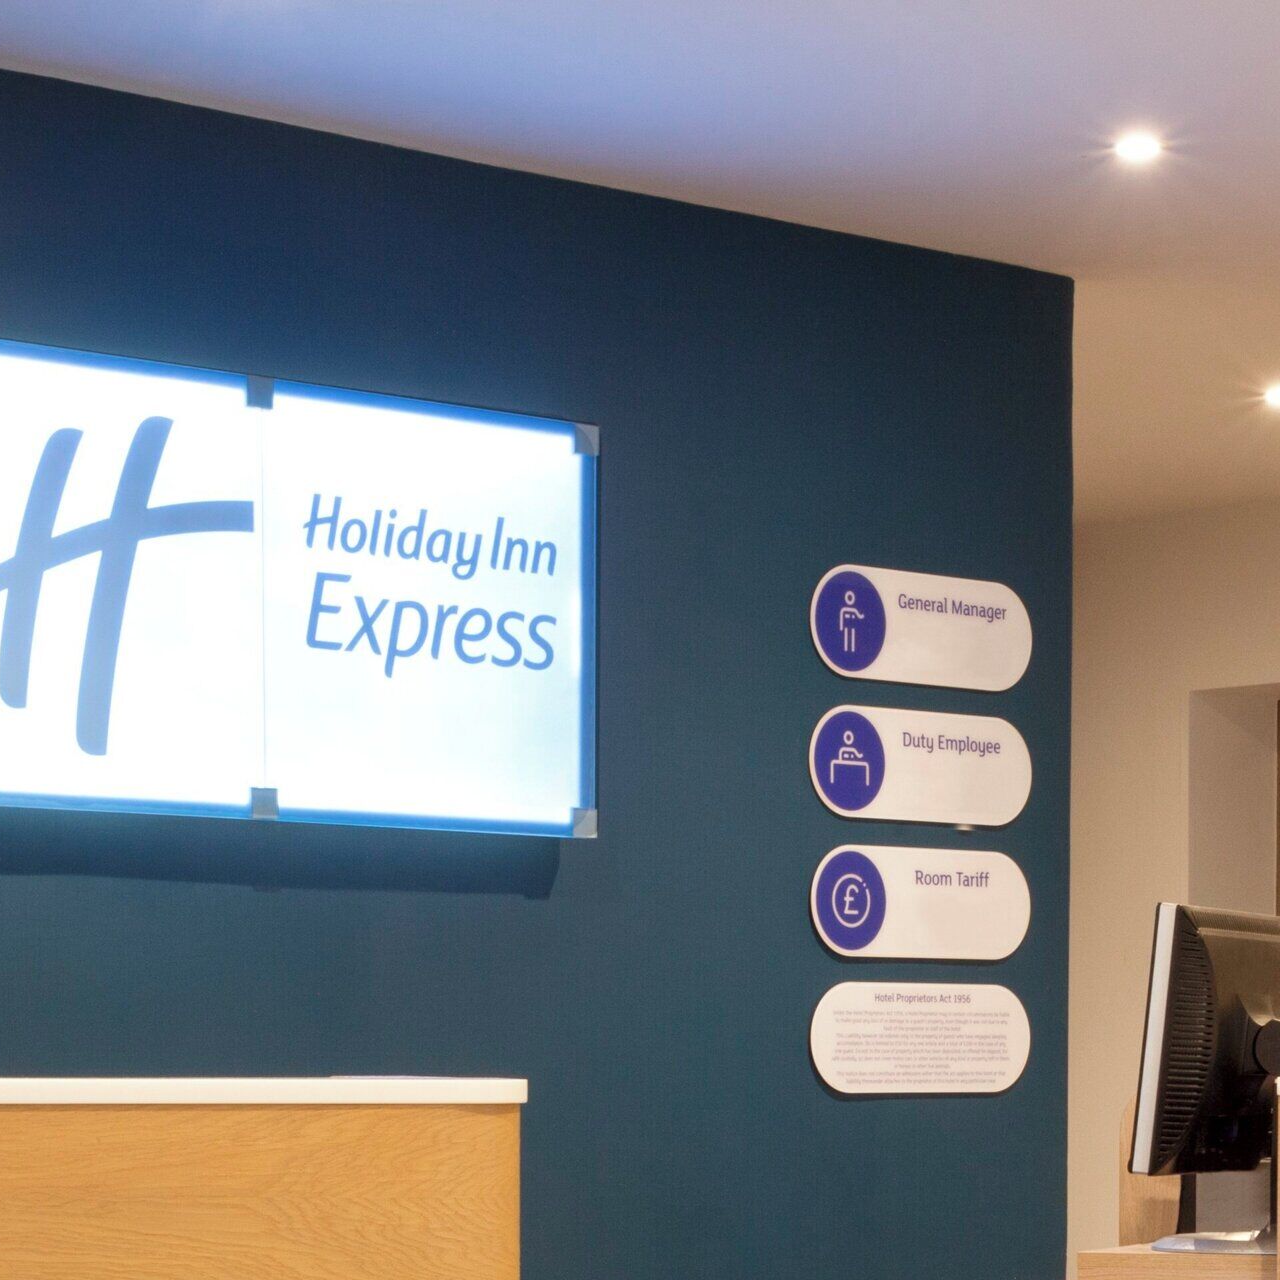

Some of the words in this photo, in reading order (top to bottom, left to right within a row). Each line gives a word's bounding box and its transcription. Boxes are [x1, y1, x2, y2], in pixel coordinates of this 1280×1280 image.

[303, 493, 483, 580] Holiday
[490, 516, 558, 577] Inn
[897, 593, 948, 614] General
[951, 599, 1007, 623] Manager
[306, 571, 558, 678] Express
[902, 731, 934, 754] Duty
[938, 735, 1001, 757] Employee
[914, 870, 952, 886] Room
[956, 871, 990, 888] Tariff
[874, 993, 895, 1003] Hotel
[896, 993, 938, 1004] Proprietors
[939, 993, 952, 1003] Act
[954, 994, 971, 1004] 1956
